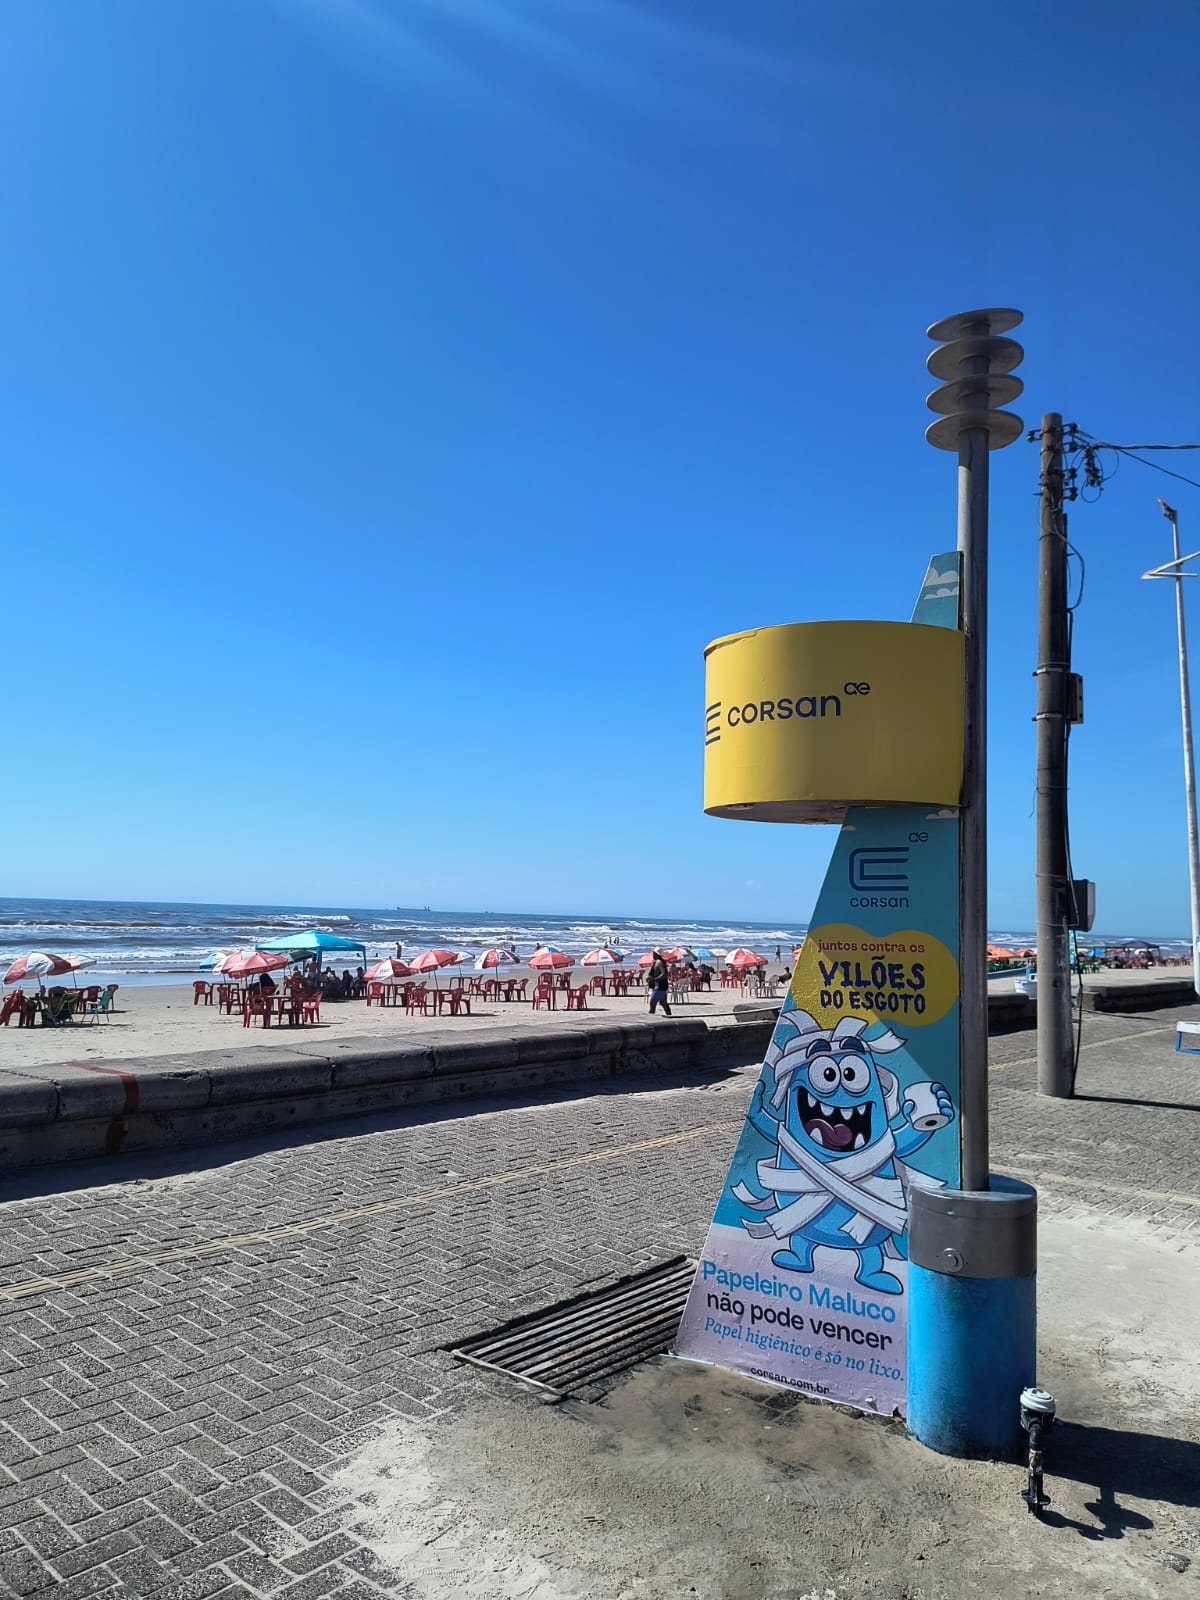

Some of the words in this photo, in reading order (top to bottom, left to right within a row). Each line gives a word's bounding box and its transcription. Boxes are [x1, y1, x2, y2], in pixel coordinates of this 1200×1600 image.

[818, 939, 858, 953] juntos
[861, 941, 906, 953] contra
[909, 944, 925, 953] os
[818, 955, 926, 991] VILÕES
[820, 989, 844, 1009] DO
[850, 991, 926, 1015] ESGOTO
[703, 1260, 803, 1302] Papeleiro
[809, 1284, 896, 1323] Maluco
[707, 1292, 745, 1316] não
[751, 1304, 804, 1331] pode
[809, 1318, 893, 1351] vencer
[705, 1317, 743, 1340] Papel
[745, 1327, 811, 1357] higiênico
[814, 1346, 823, 1361] é
[825, 1351, 842, 1365] só
[845, 1356, 865, 1371] no
[869, 1358, 904, 1381] lixo.
[750, 1367, 830, 1394] corsan.com.br
